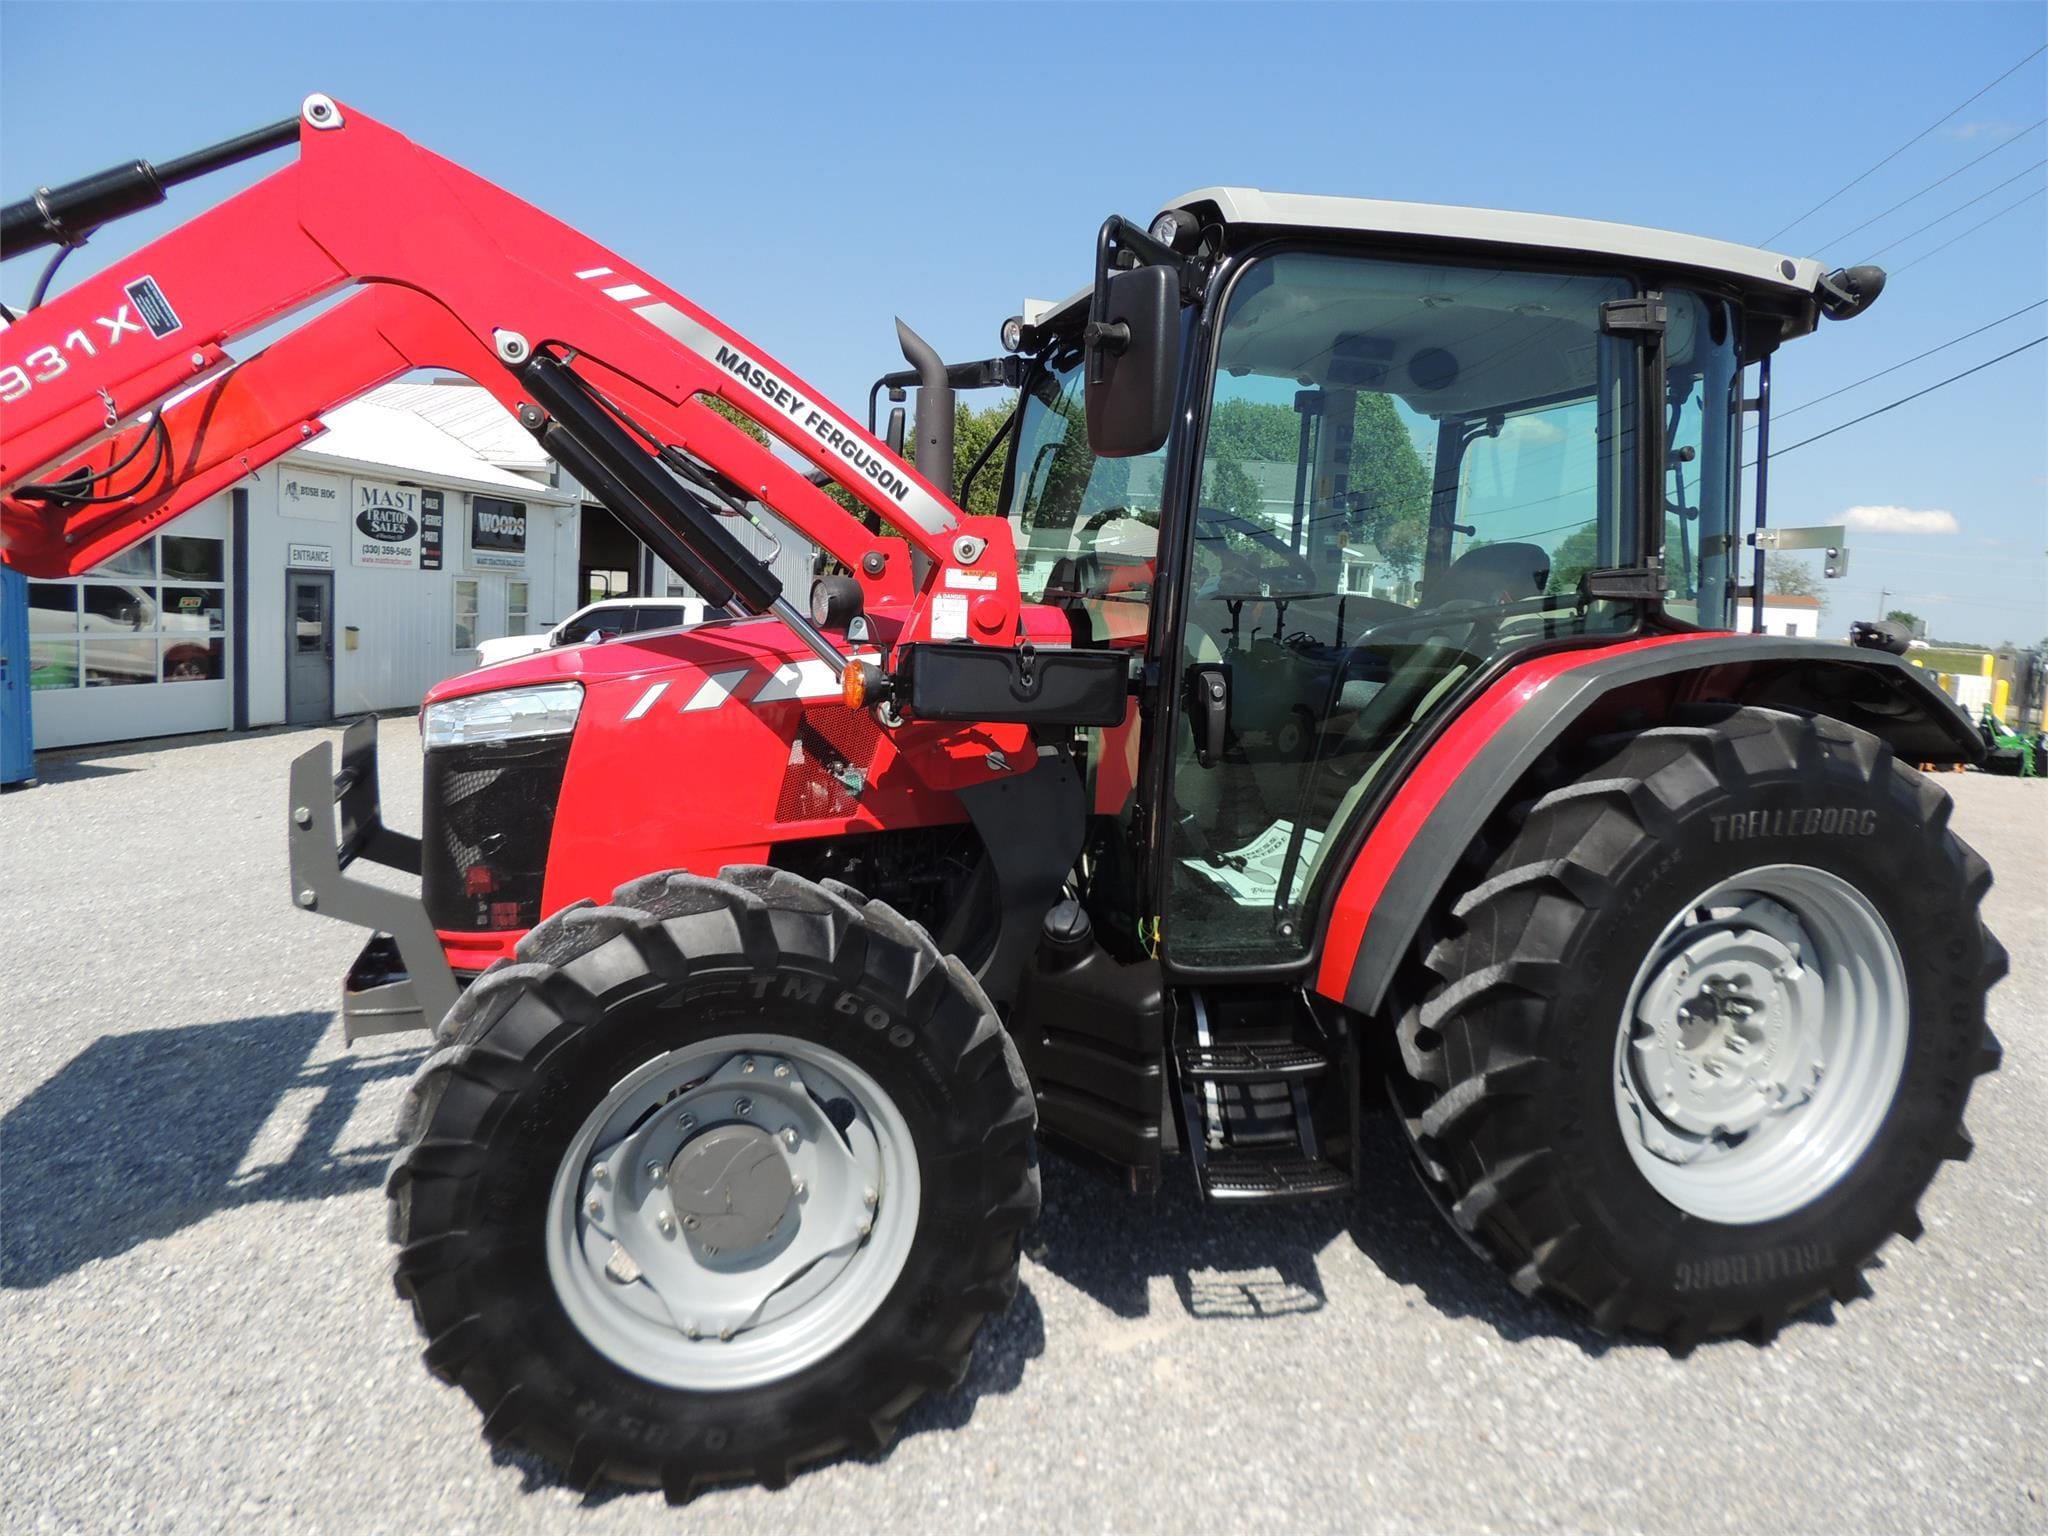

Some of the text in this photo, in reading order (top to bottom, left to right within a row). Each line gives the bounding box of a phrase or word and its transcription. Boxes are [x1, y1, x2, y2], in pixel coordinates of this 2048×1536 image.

[714, 345, 910, 502] MASSEY FERGUSON
[300, 486, 336, 499] BUSH HOG
[361, 486, 417, 512] MAST
[367, 502, 408, 524] TRACTOR
[478, 512, 525, 536] WOODS
[371, 520, 406, 533] SALES
[292, 549, 330, 562] ENTRANCE
[362, 544, 380, 556] (330)
[381, 545, 413, 556] 359-5405
[1710, 808, 1877, 843] TRELLEBORG
[750, 975, 916, 1048] TM 600
